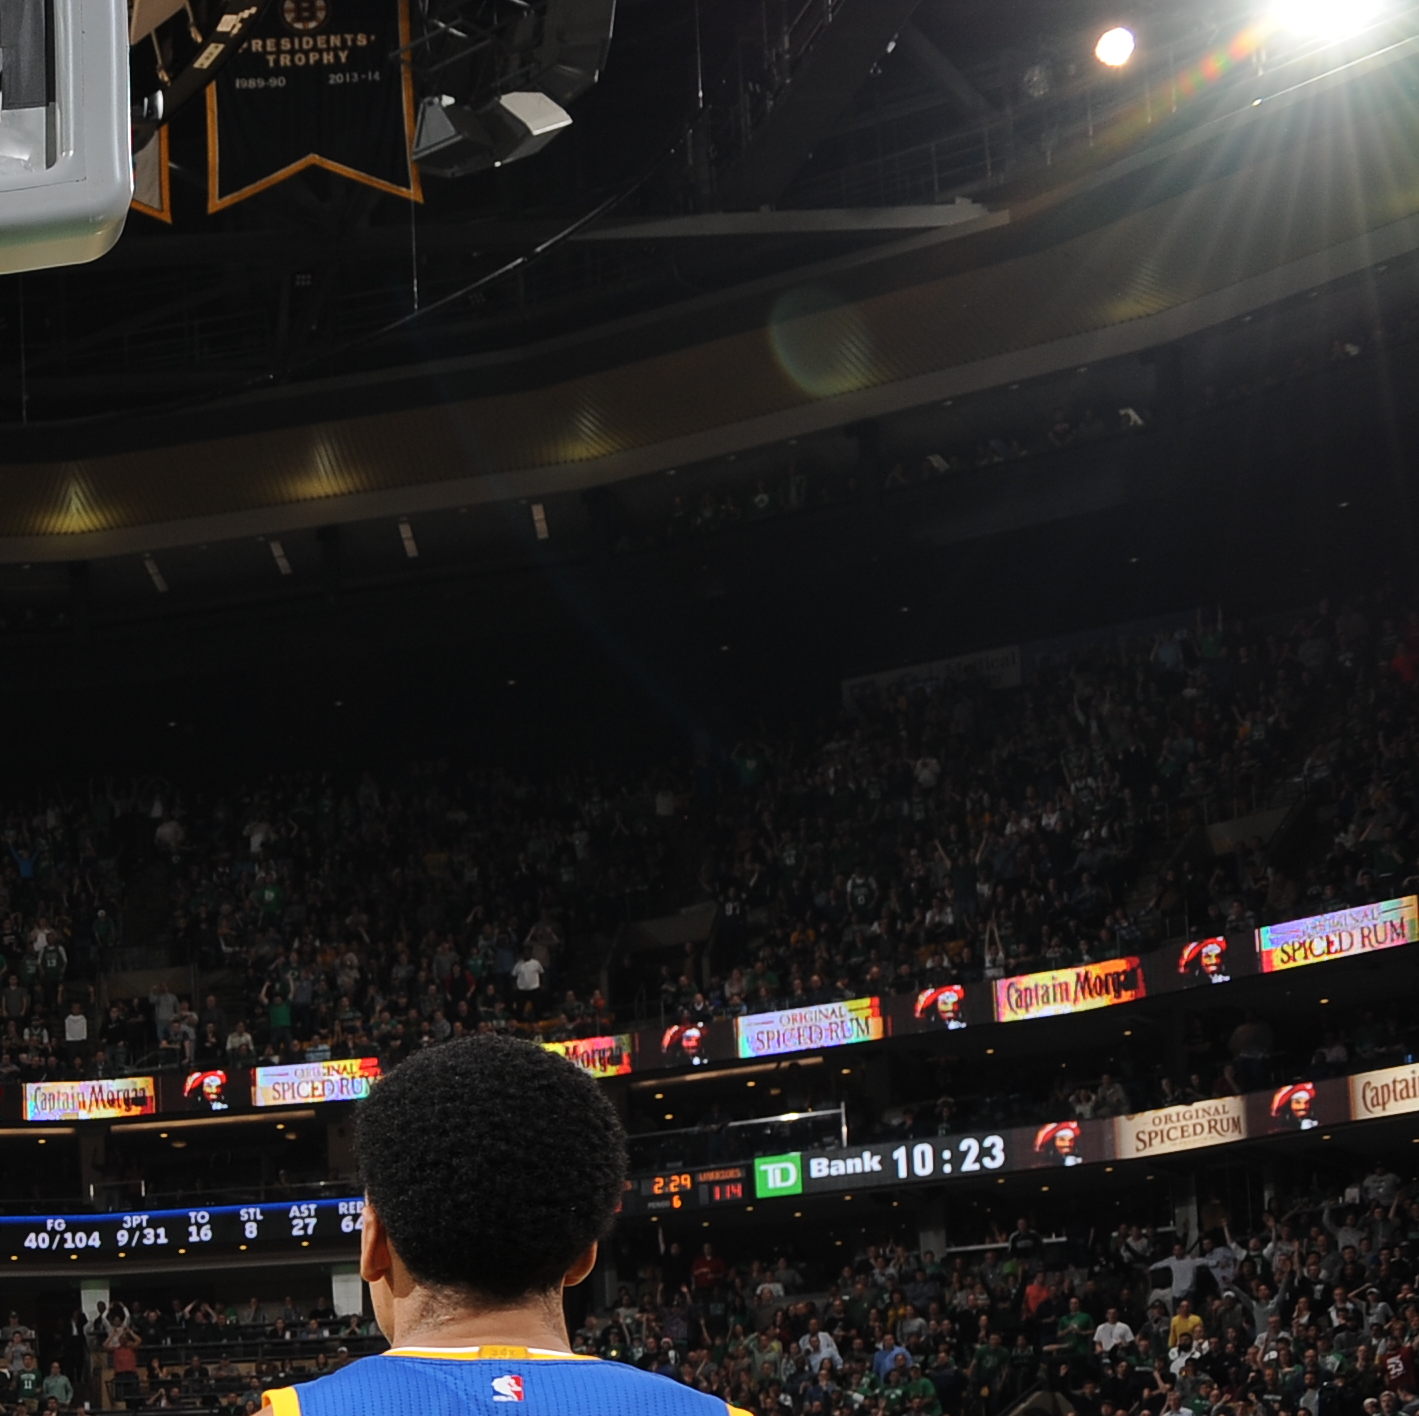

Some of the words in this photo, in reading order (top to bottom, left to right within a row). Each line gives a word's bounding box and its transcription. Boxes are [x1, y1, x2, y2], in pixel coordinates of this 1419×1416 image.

[266, 50, 349, 68] TROPHY
[328, 71, 380, 85] 2013-14
[1279, 932, 1356, 964] SPICED
[1361, 917, 1408, 948] RUM
[1006, 981, 1070, 1014] Captain
[779, 1007, 845, 1027] ORIGINAL
[828, 1017, 872, 1041] RUM
[271, 1076, 336, 1101] SPICED
[1361, 1069, 1419, 1114] Captai
[34, 1085, 86, 1114] Captain
[1151, 1103, 1230, 1128] ORIGINAL
[1134, 1121, 1208, 1153] SPICED
[1207, 1114, 1243, 1138] RUM
[892, 1134, 1006, 1178] 10:23
[760, 1160, 798, 1188] TD
[809, 1151, 883, 1179] Bank
[652, 1173, 692, 1195] 2:29
[713, 1183, 743, 1200] 114
[289, 1204, 317, 1218] AST
[672, 1194, 682, 1209] 6
[122, 1215, 149, 1229] 3PT
[188, 1211, 210, 1224] TO
[239, 1208, 263, 1222] STL
[46, 1218, 67, 1232] FG
[188, 1225, 212, 1243] 16
[244, 1221, 258, 1239] 8
[291, 1218, 317, 1236] 27
[23, 1231, 102, 1250] 40/104
[116, 1227, 168, 1248] 9/31
[24, 1380, 33, 1390] 11
